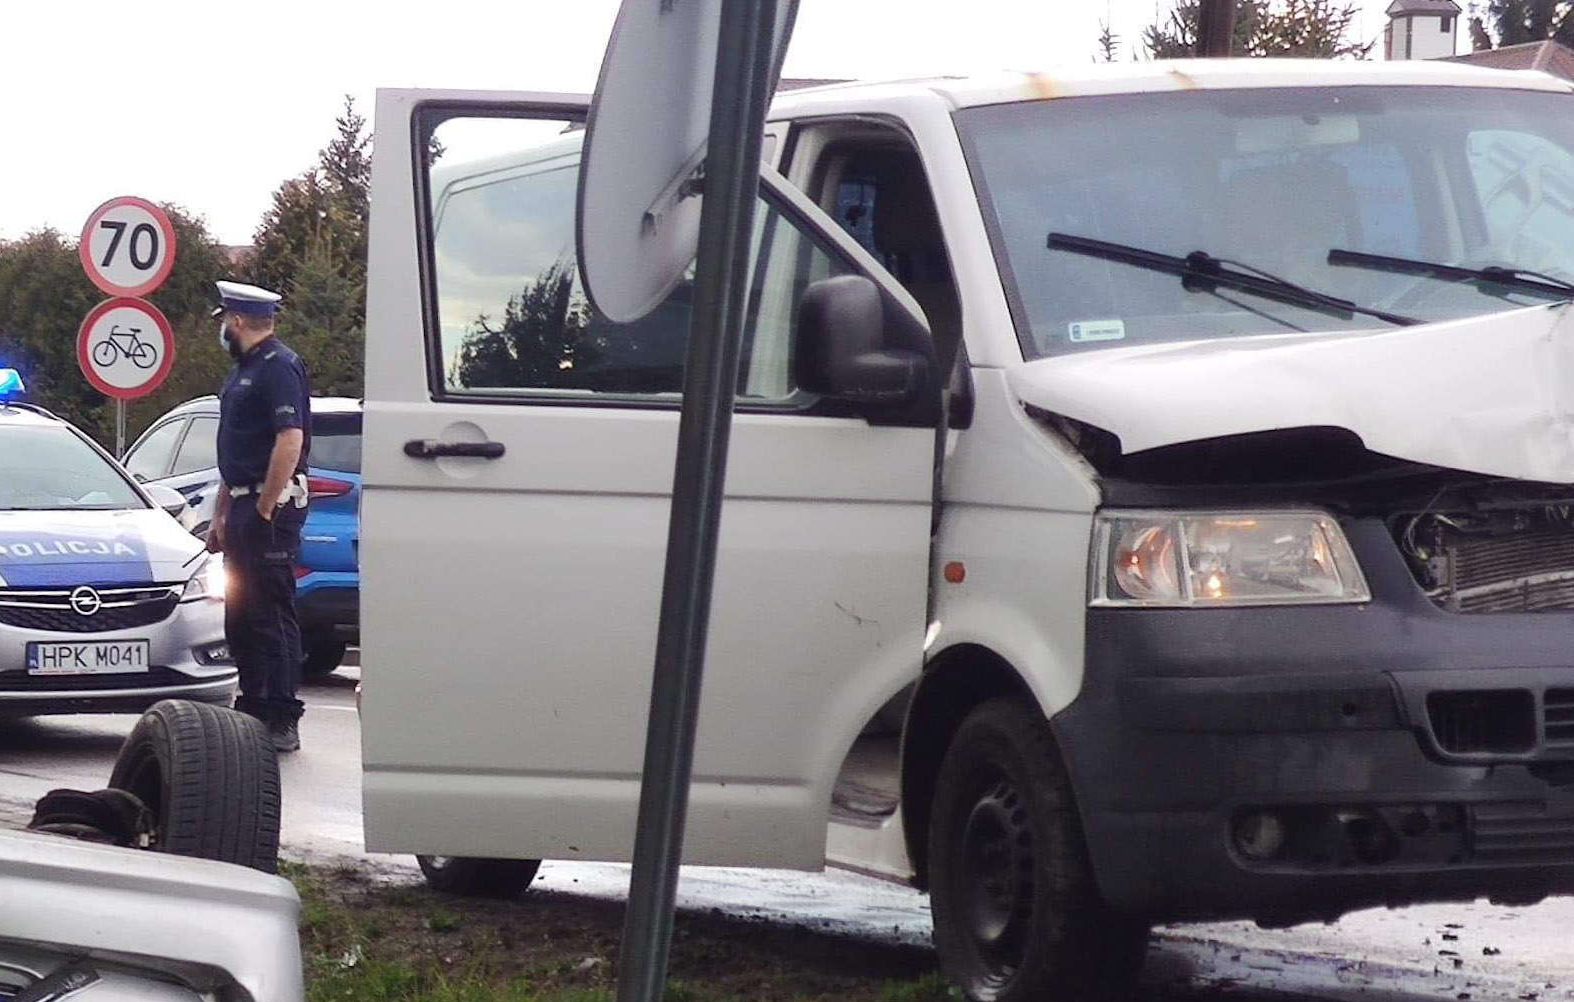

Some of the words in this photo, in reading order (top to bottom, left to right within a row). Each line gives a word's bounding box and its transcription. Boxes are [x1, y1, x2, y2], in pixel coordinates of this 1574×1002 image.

[100, 220, 159, 271] 70
[42, 646, 87, 668] HPK
[95, 645, 142, 666] M041
